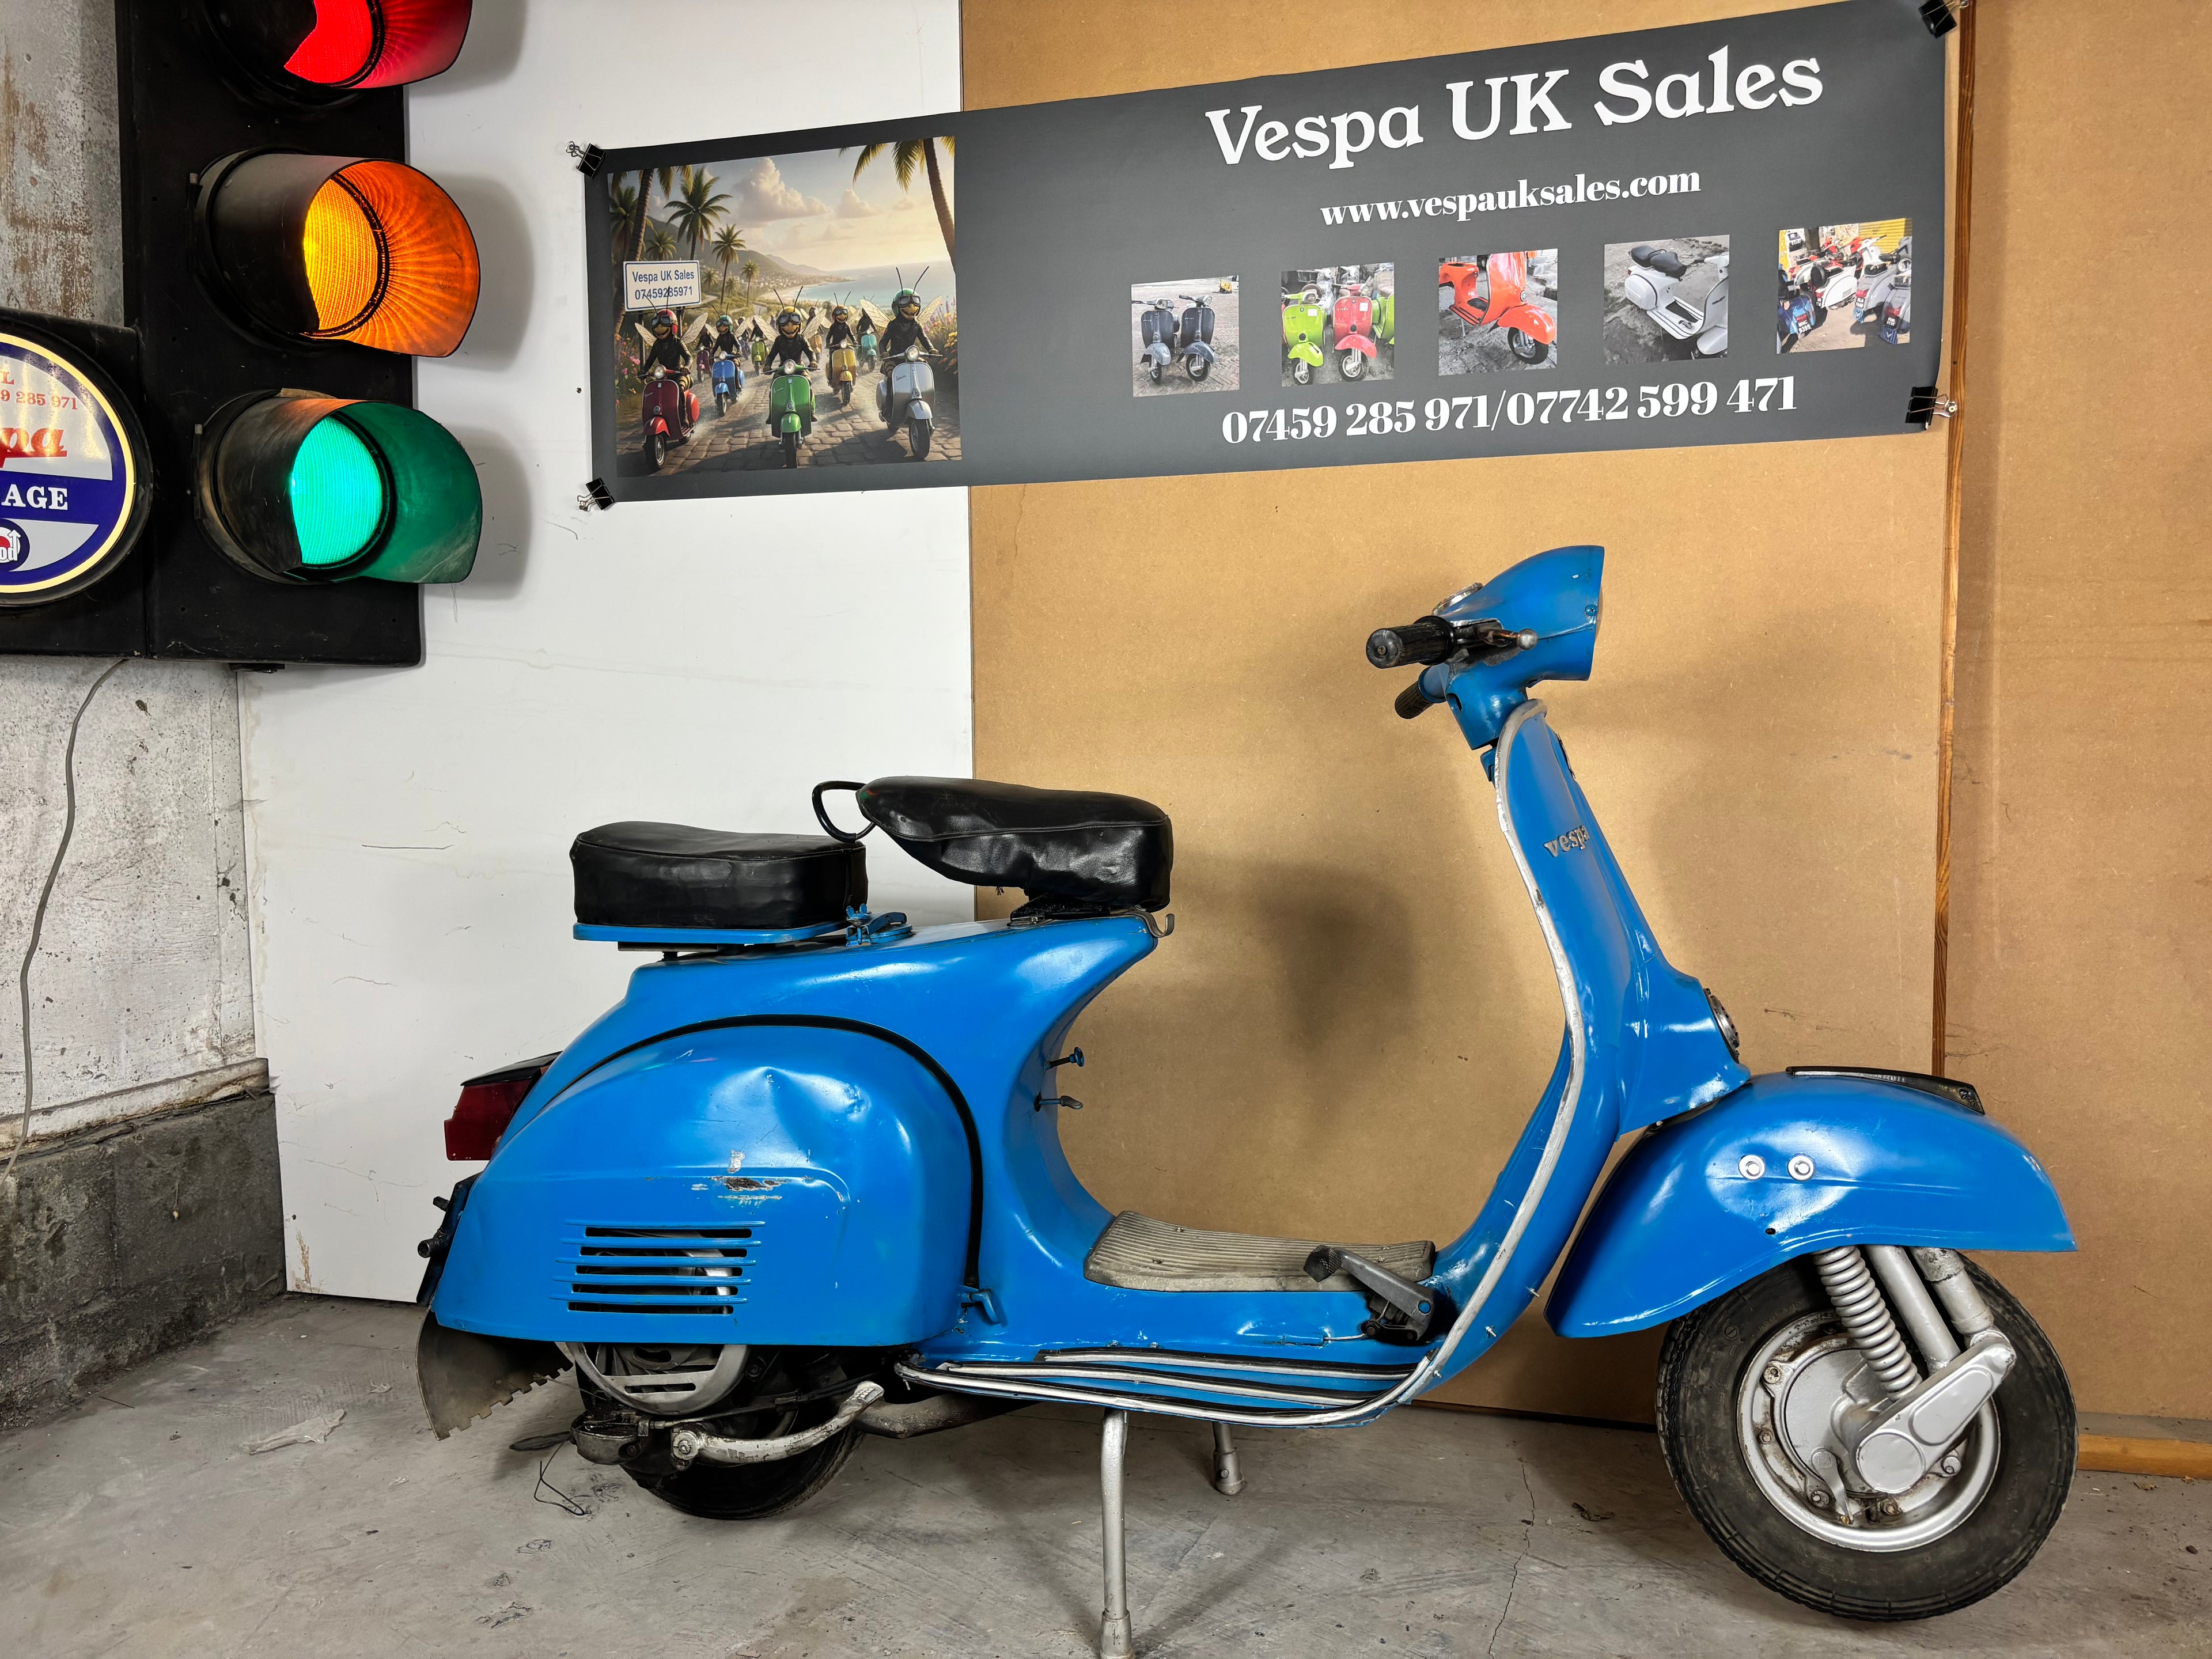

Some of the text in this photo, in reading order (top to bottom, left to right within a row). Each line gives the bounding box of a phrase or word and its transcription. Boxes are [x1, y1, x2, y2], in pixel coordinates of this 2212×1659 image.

[1205, 45, 1824, 169] Vespa UK Sales
[1320, 172, 1702, 225] www.vespauksales.com
[632, 269, 694, 285] Vespa UK Sales
[635, 286, 692, 300] 07459285971
[16, 391, 46, 406] 285
[51, 395, 78, 410] 971
[1222, 376, 1798, 444] 07459 285 971/07742 599 471
[1, 484, 68, 510] AGE
